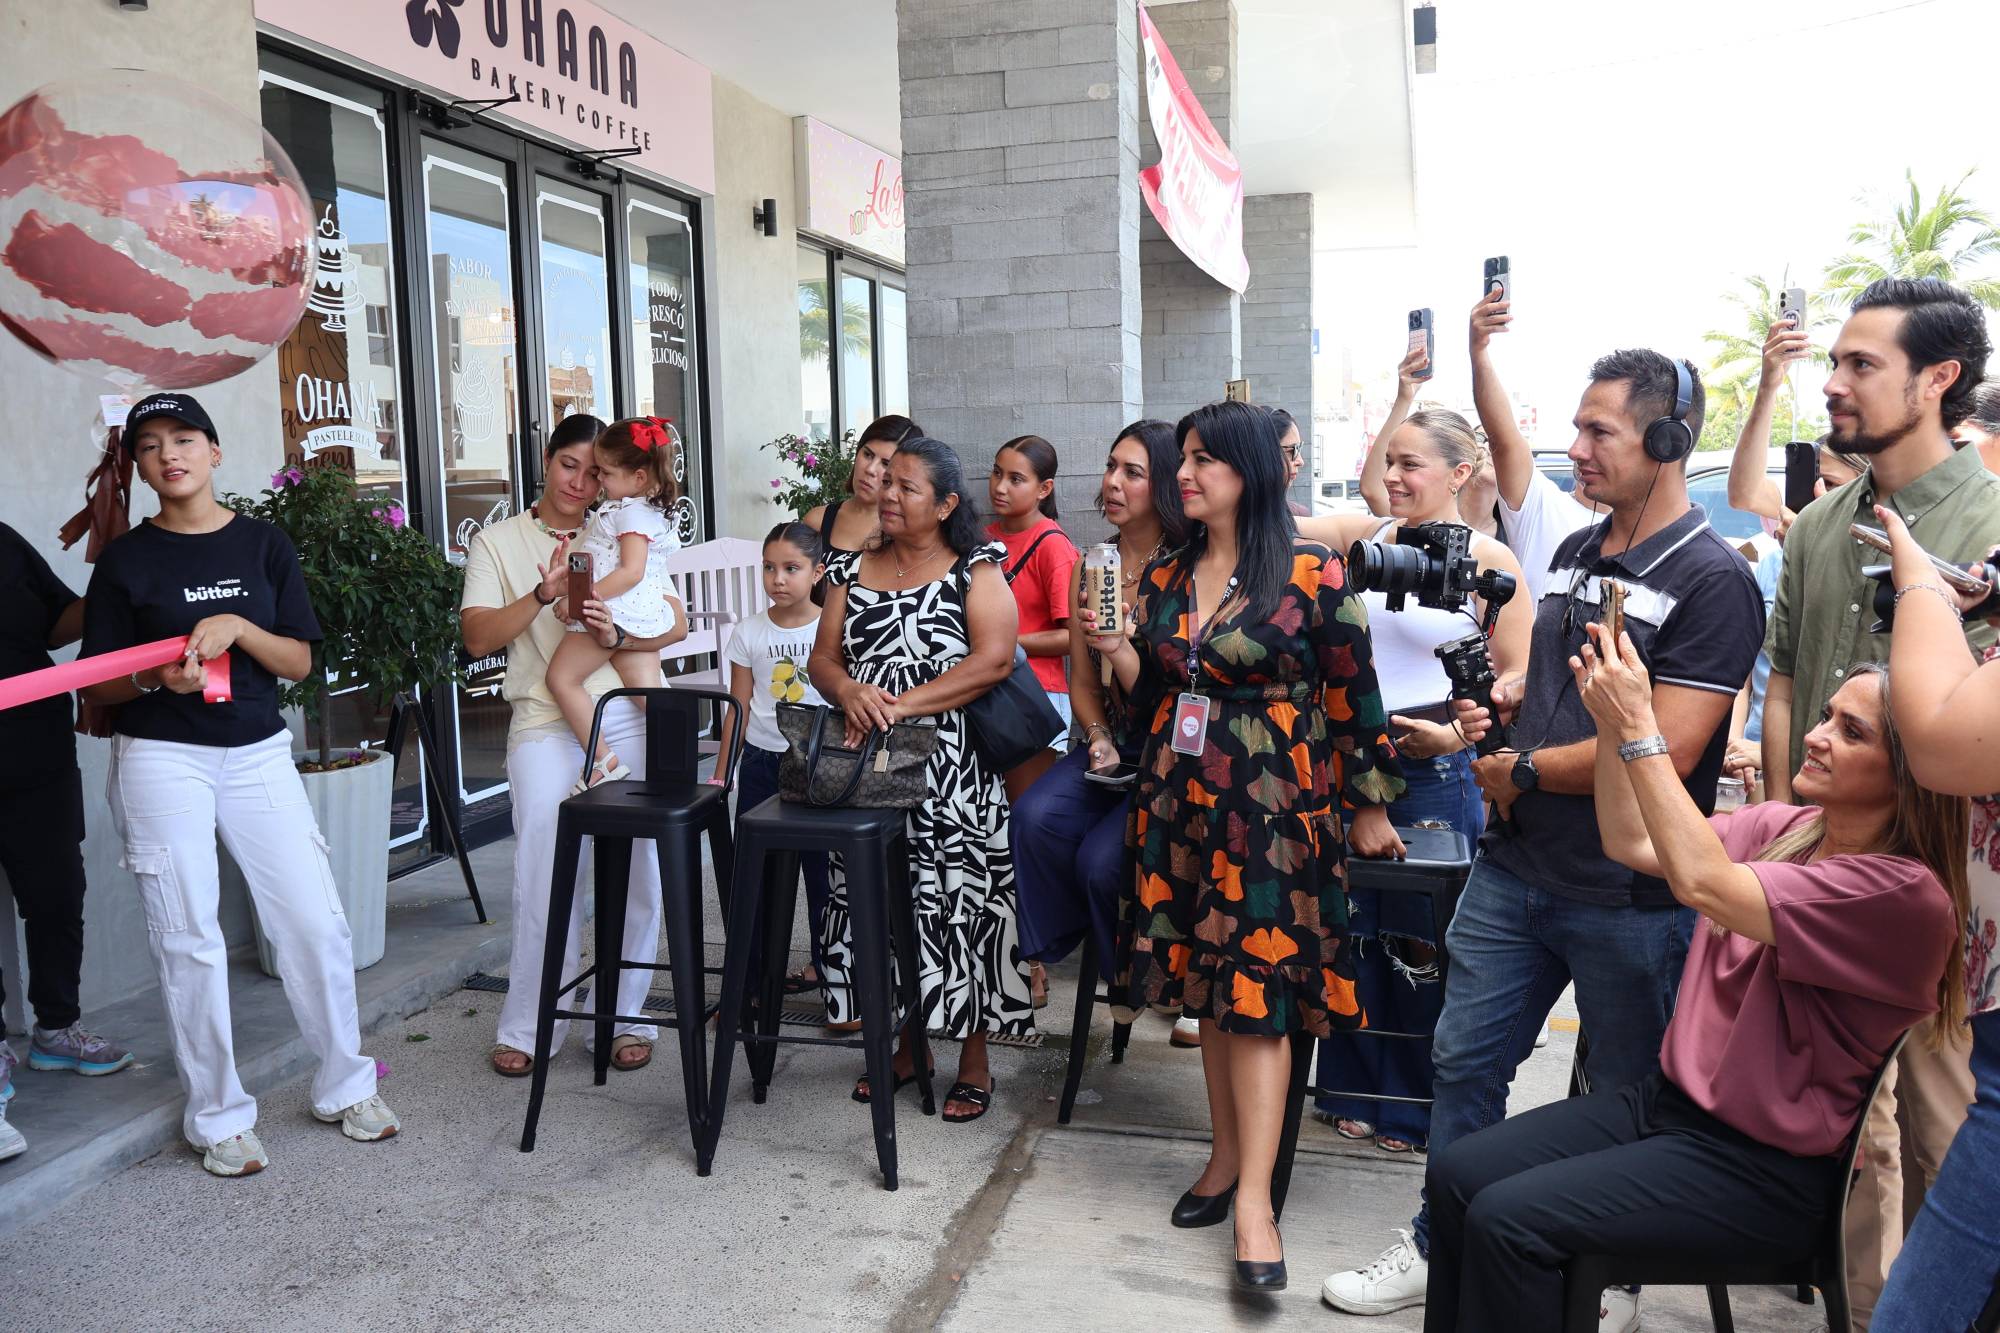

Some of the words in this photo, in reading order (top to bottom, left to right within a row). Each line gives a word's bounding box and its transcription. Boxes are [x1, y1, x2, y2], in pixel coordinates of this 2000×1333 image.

[471, 58, 567, 115] BAKERY
[577, 104, 651, 151] COFFEE
[449, 255, 493, 281] SABOR
[649, 281, 678, 302] TODO
[648, 303, 685, 330] RESCO
[662, 330, 669, 343] Y
[648, 346, 688, 371] ELICIOSO
[296, 373, 383, 429] OHANA
[183, 586, 249, 602] bütter.
[1098, 559, 1117, 631] bütter.
[465, 655, 508, 681] ¡PRUÉBAL
